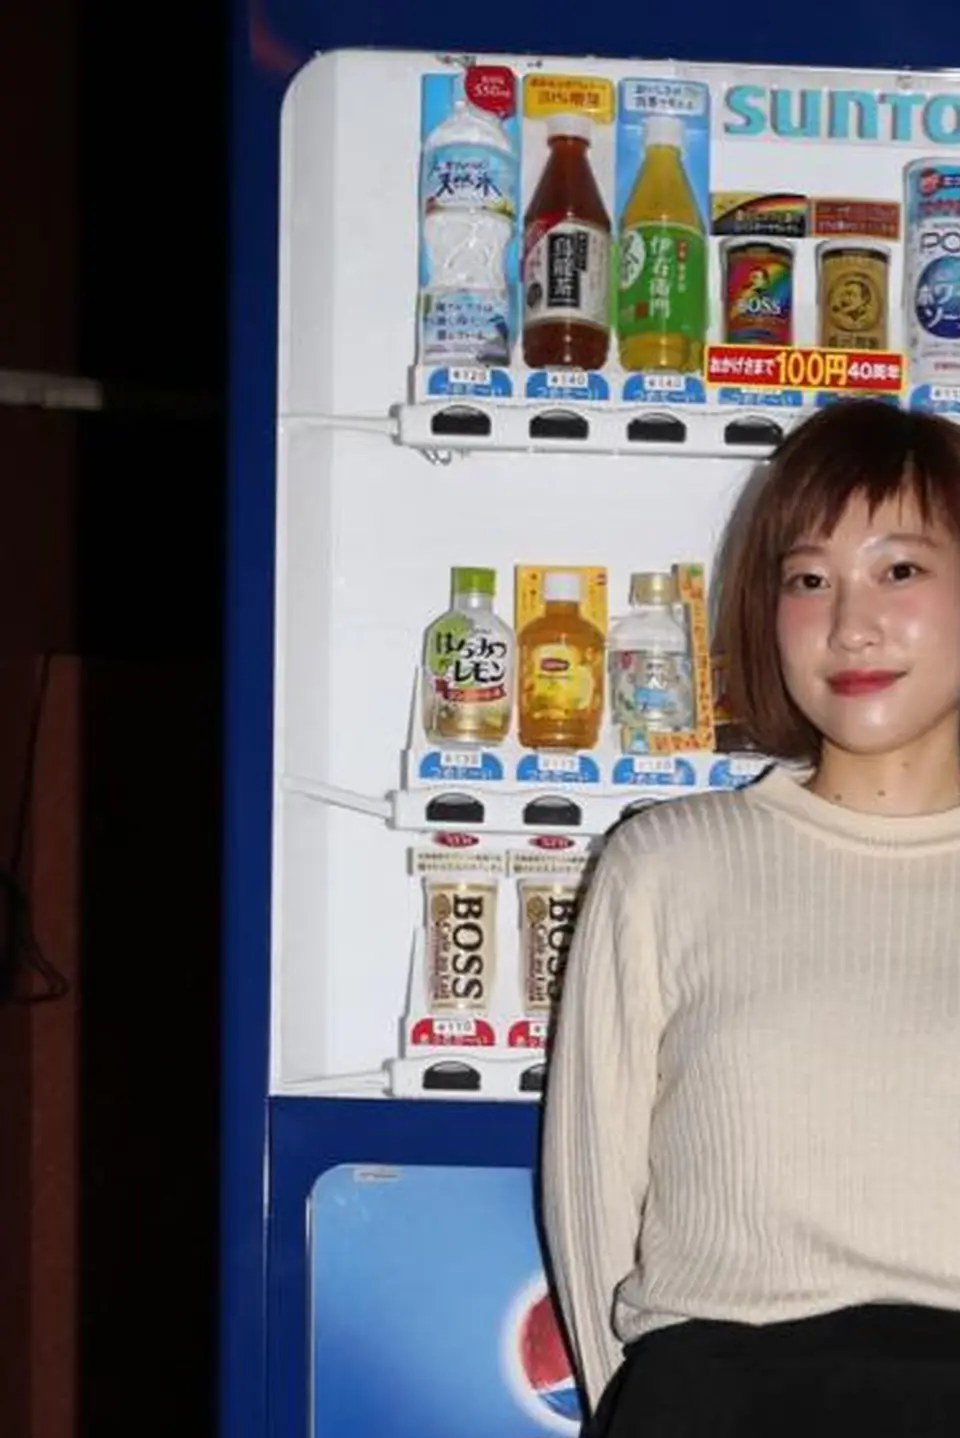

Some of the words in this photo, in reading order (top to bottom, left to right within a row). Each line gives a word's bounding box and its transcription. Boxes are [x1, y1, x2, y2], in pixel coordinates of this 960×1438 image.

[776, 351, 848, 386] 100円
[455, 659, 506, 683] レモン
[452, 895, 484, 1000] BOSS
